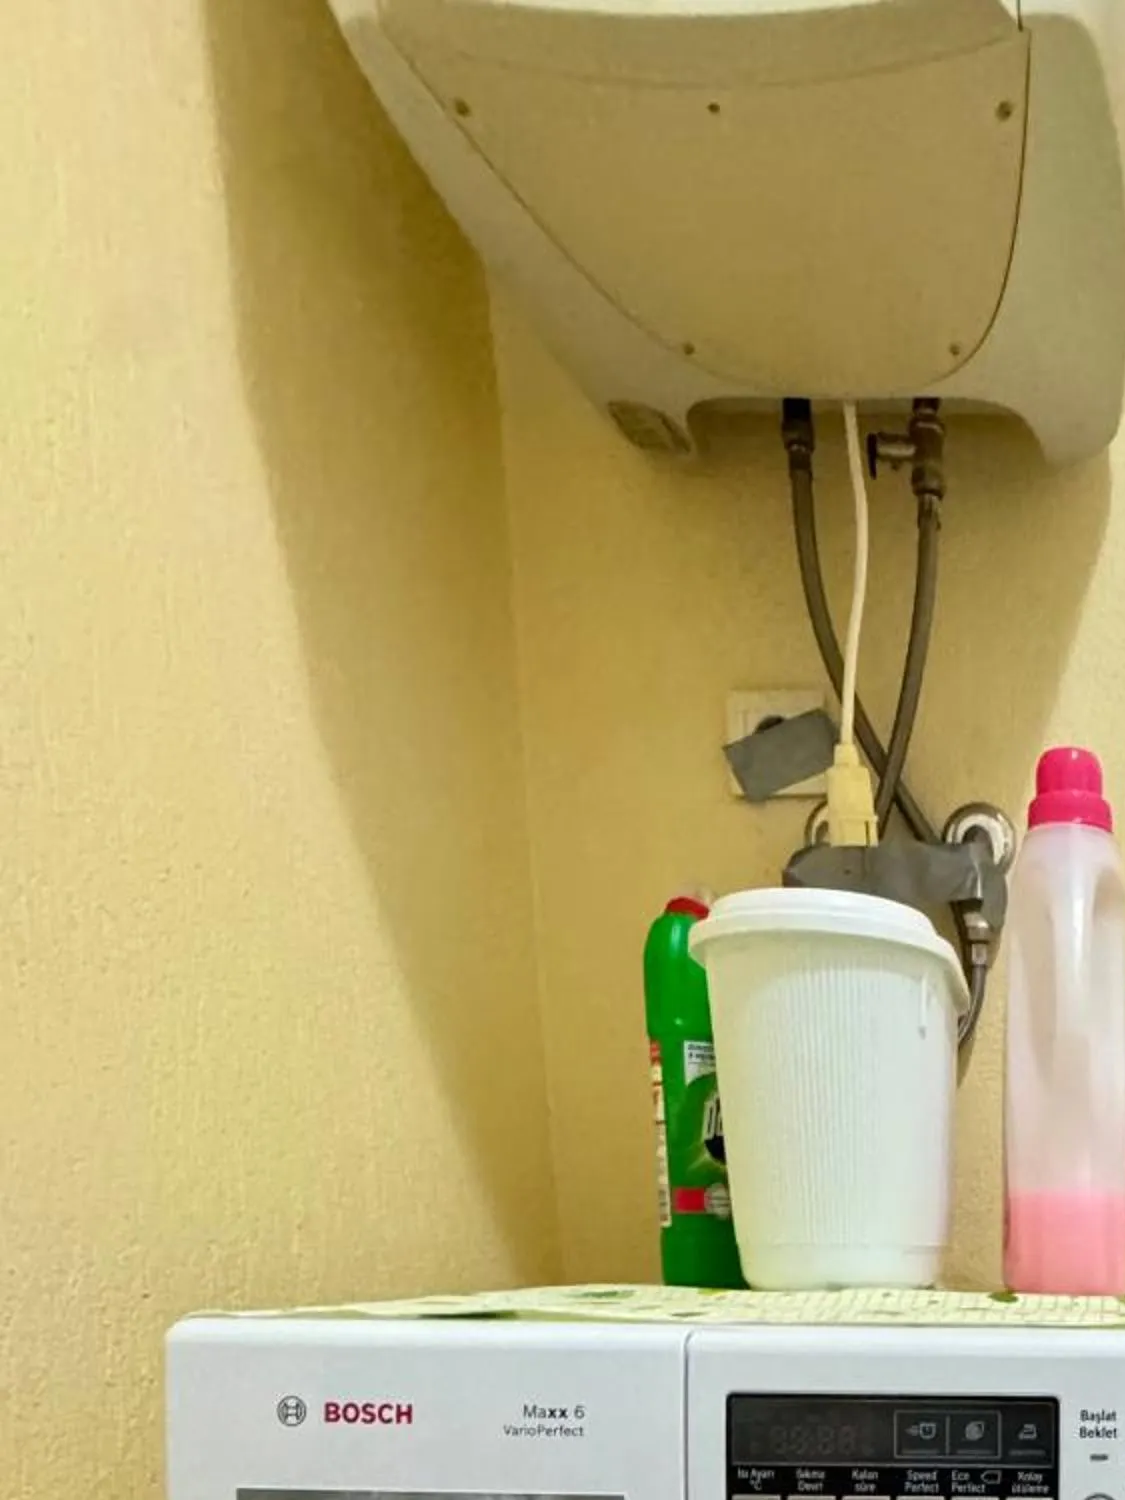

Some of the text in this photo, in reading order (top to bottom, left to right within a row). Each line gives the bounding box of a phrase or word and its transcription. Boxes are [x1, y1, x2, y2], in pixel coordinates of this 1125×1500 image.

[324, 1402, 413, 1425] BOSCH
[522, 1404, 586, 1420] Maxx 6
[1080, 1409, 1117, 1424] Başlat
[503, 1424, 585, 1438] VarioPerfect
[1079, 1426, 1117, 1439] Beklet
[904, 1481, 940, 1493] Perfect
[951, 1482, 986, 1493] Perfect
